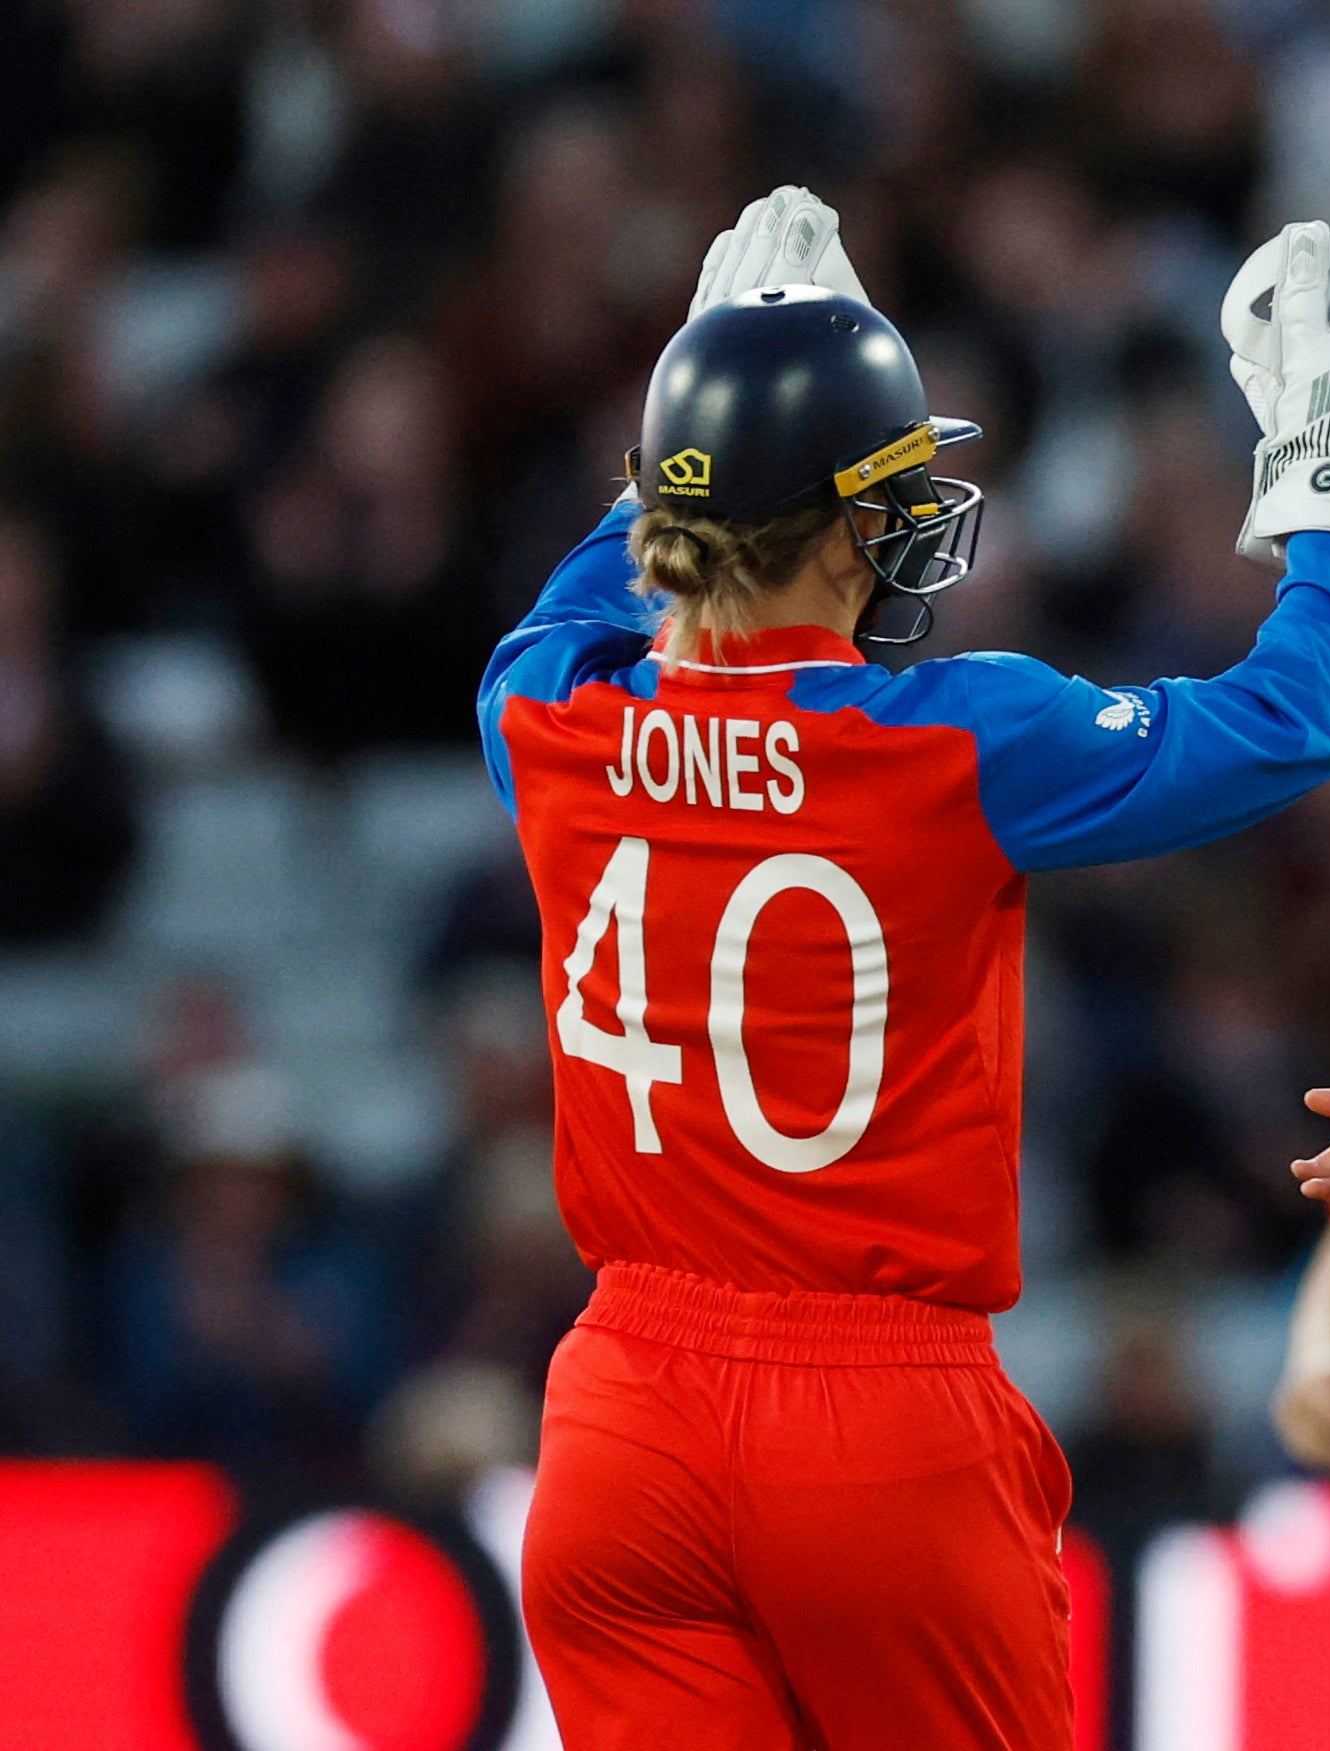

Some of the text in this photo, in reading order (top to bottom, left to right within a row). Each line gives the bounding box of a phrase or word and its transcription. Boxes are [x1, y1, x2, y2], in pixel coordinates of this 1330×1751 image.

[872, 436, 924, 470] MASURI
[658, 484, 710, 497] MASURI
[605, 705, 805, 815] JONES
[556, 836, 890, 1173] 40
